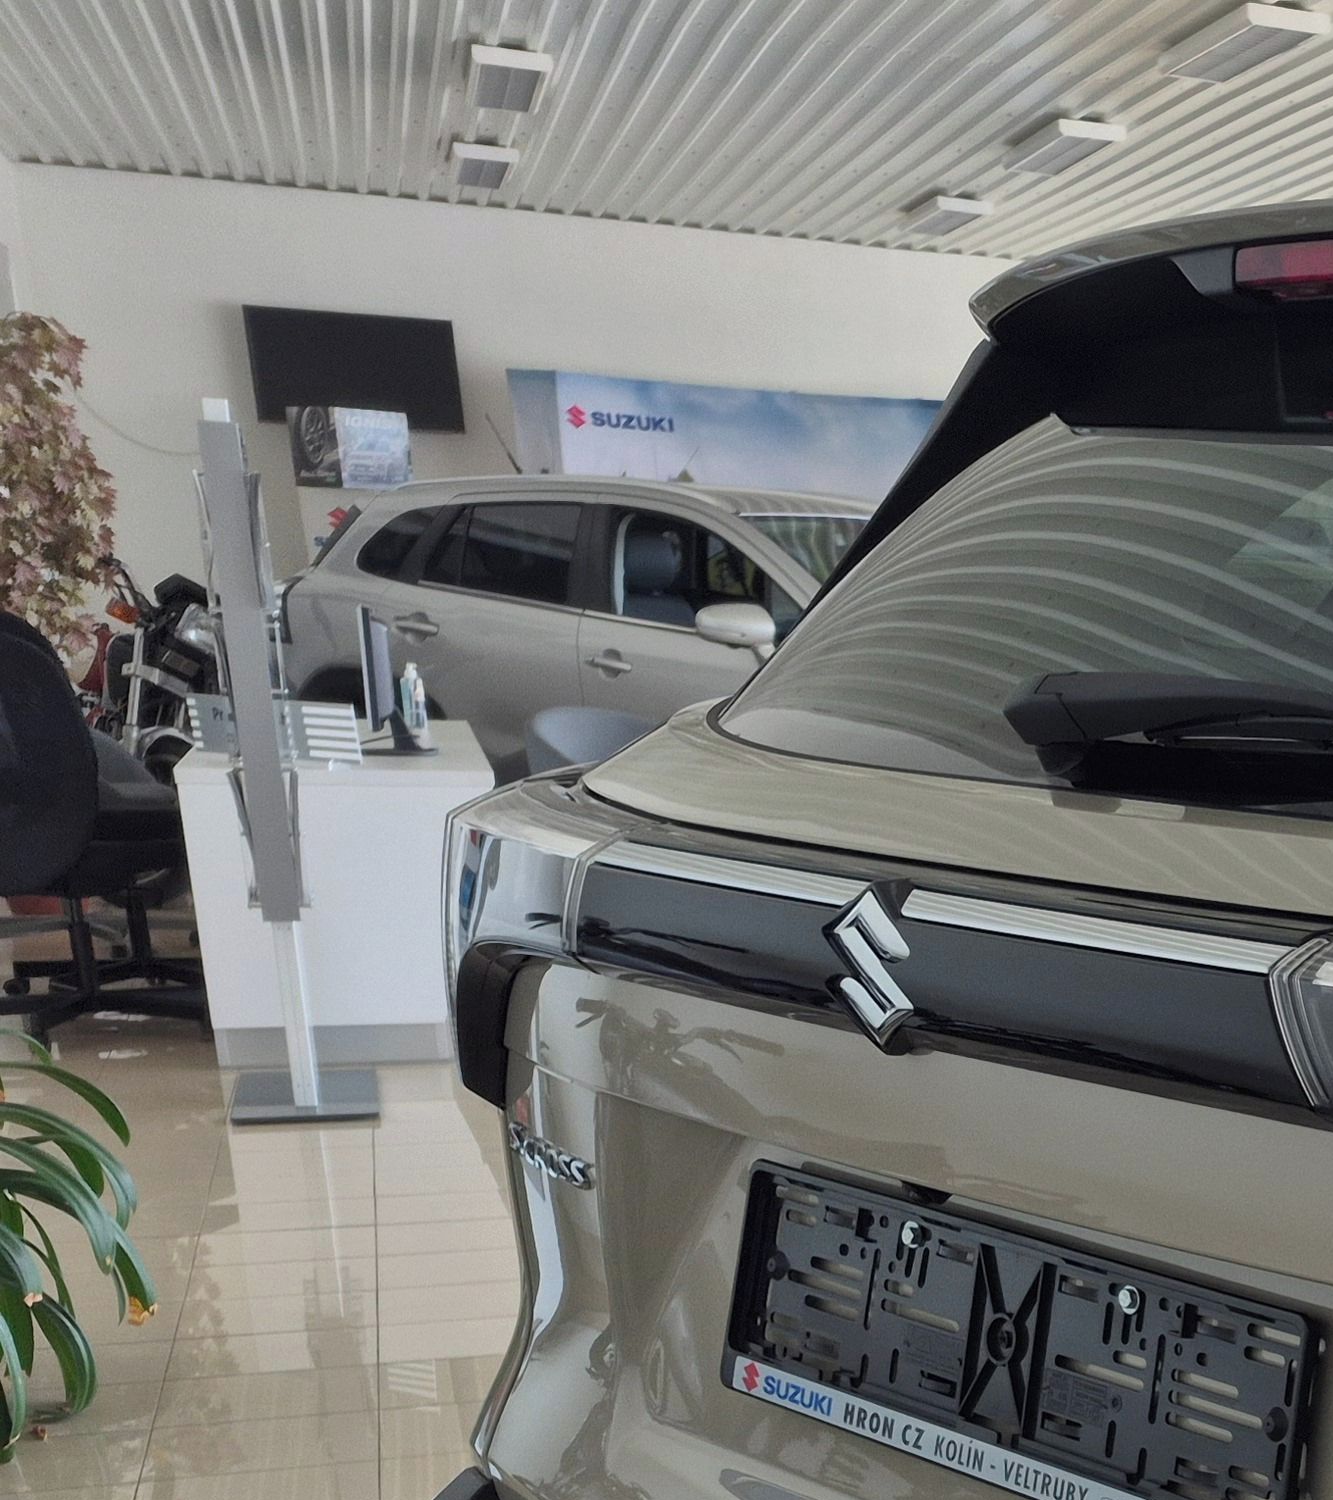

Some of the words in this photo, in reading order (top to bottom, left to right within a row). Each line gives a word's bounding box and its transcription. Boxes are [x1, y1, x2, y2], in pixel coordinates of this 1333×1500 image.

[590, 411, 675, 433] SUZUKI
[762, 1375, 834, 1417] SUZUKI
[843, 1402, 895, 1440] HRON
[901, 1423, 926, 1450] CZ
[934, 1434, 985, 1473] KOLÍN
